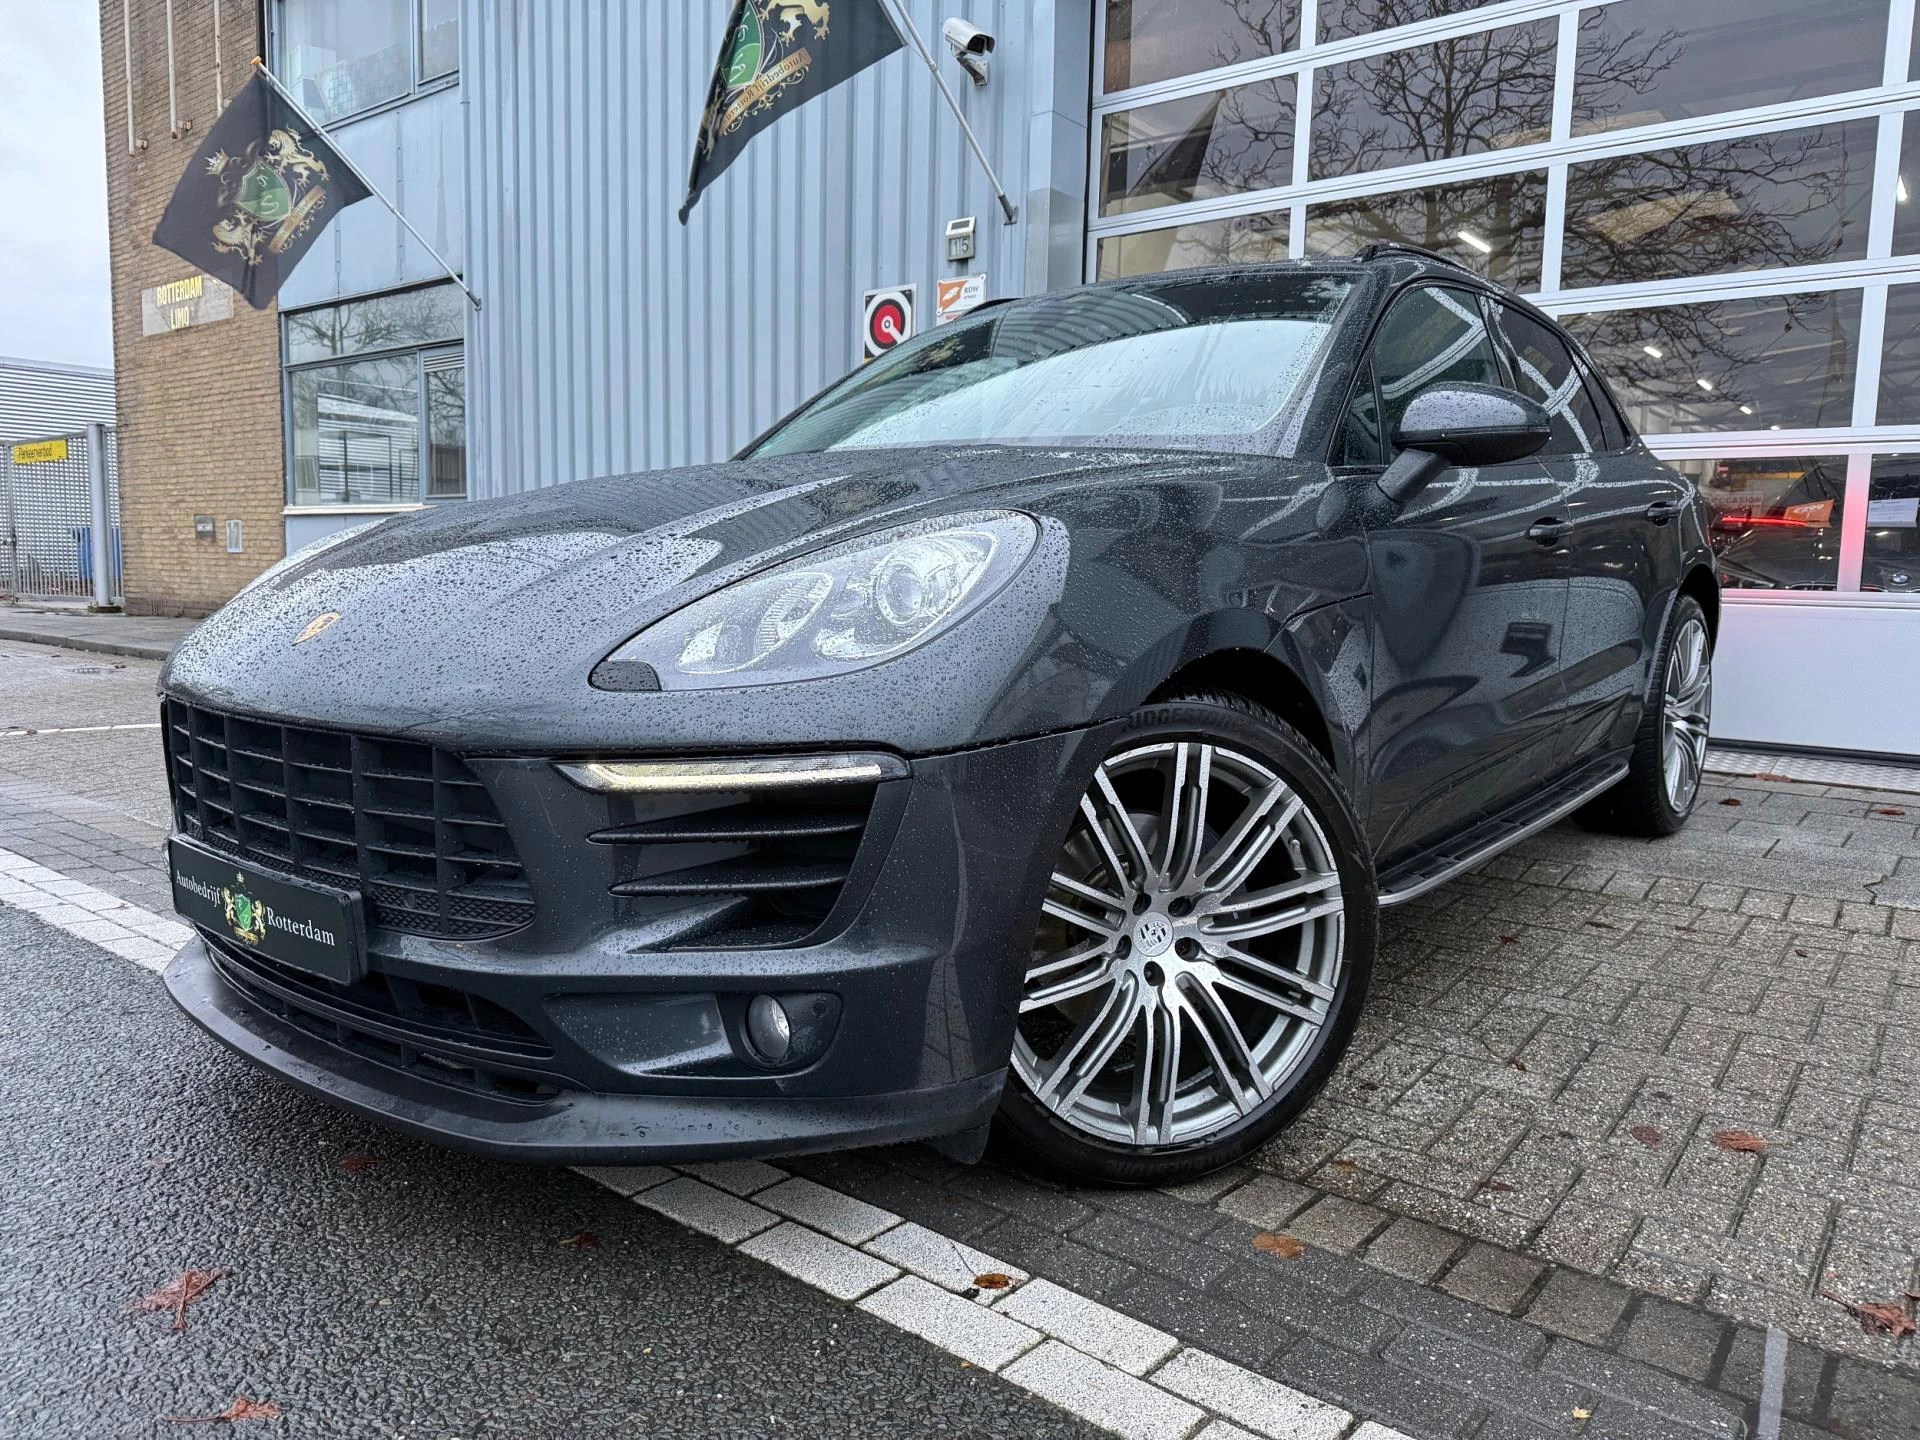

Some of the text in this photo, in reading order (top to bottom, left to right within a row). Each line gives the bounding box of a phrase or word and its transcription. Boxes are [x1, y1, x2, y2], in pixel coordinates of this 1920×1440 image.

[952, 237, 969, 255] 15
[157, 275, 202, 307] ROTTERDAM
[170, 306, 190, 330] LIMO
[1121, 707, 1246, 733] RIDGESTONE
[175, 869, 336, 946] Autobedrijf Rotterdam
